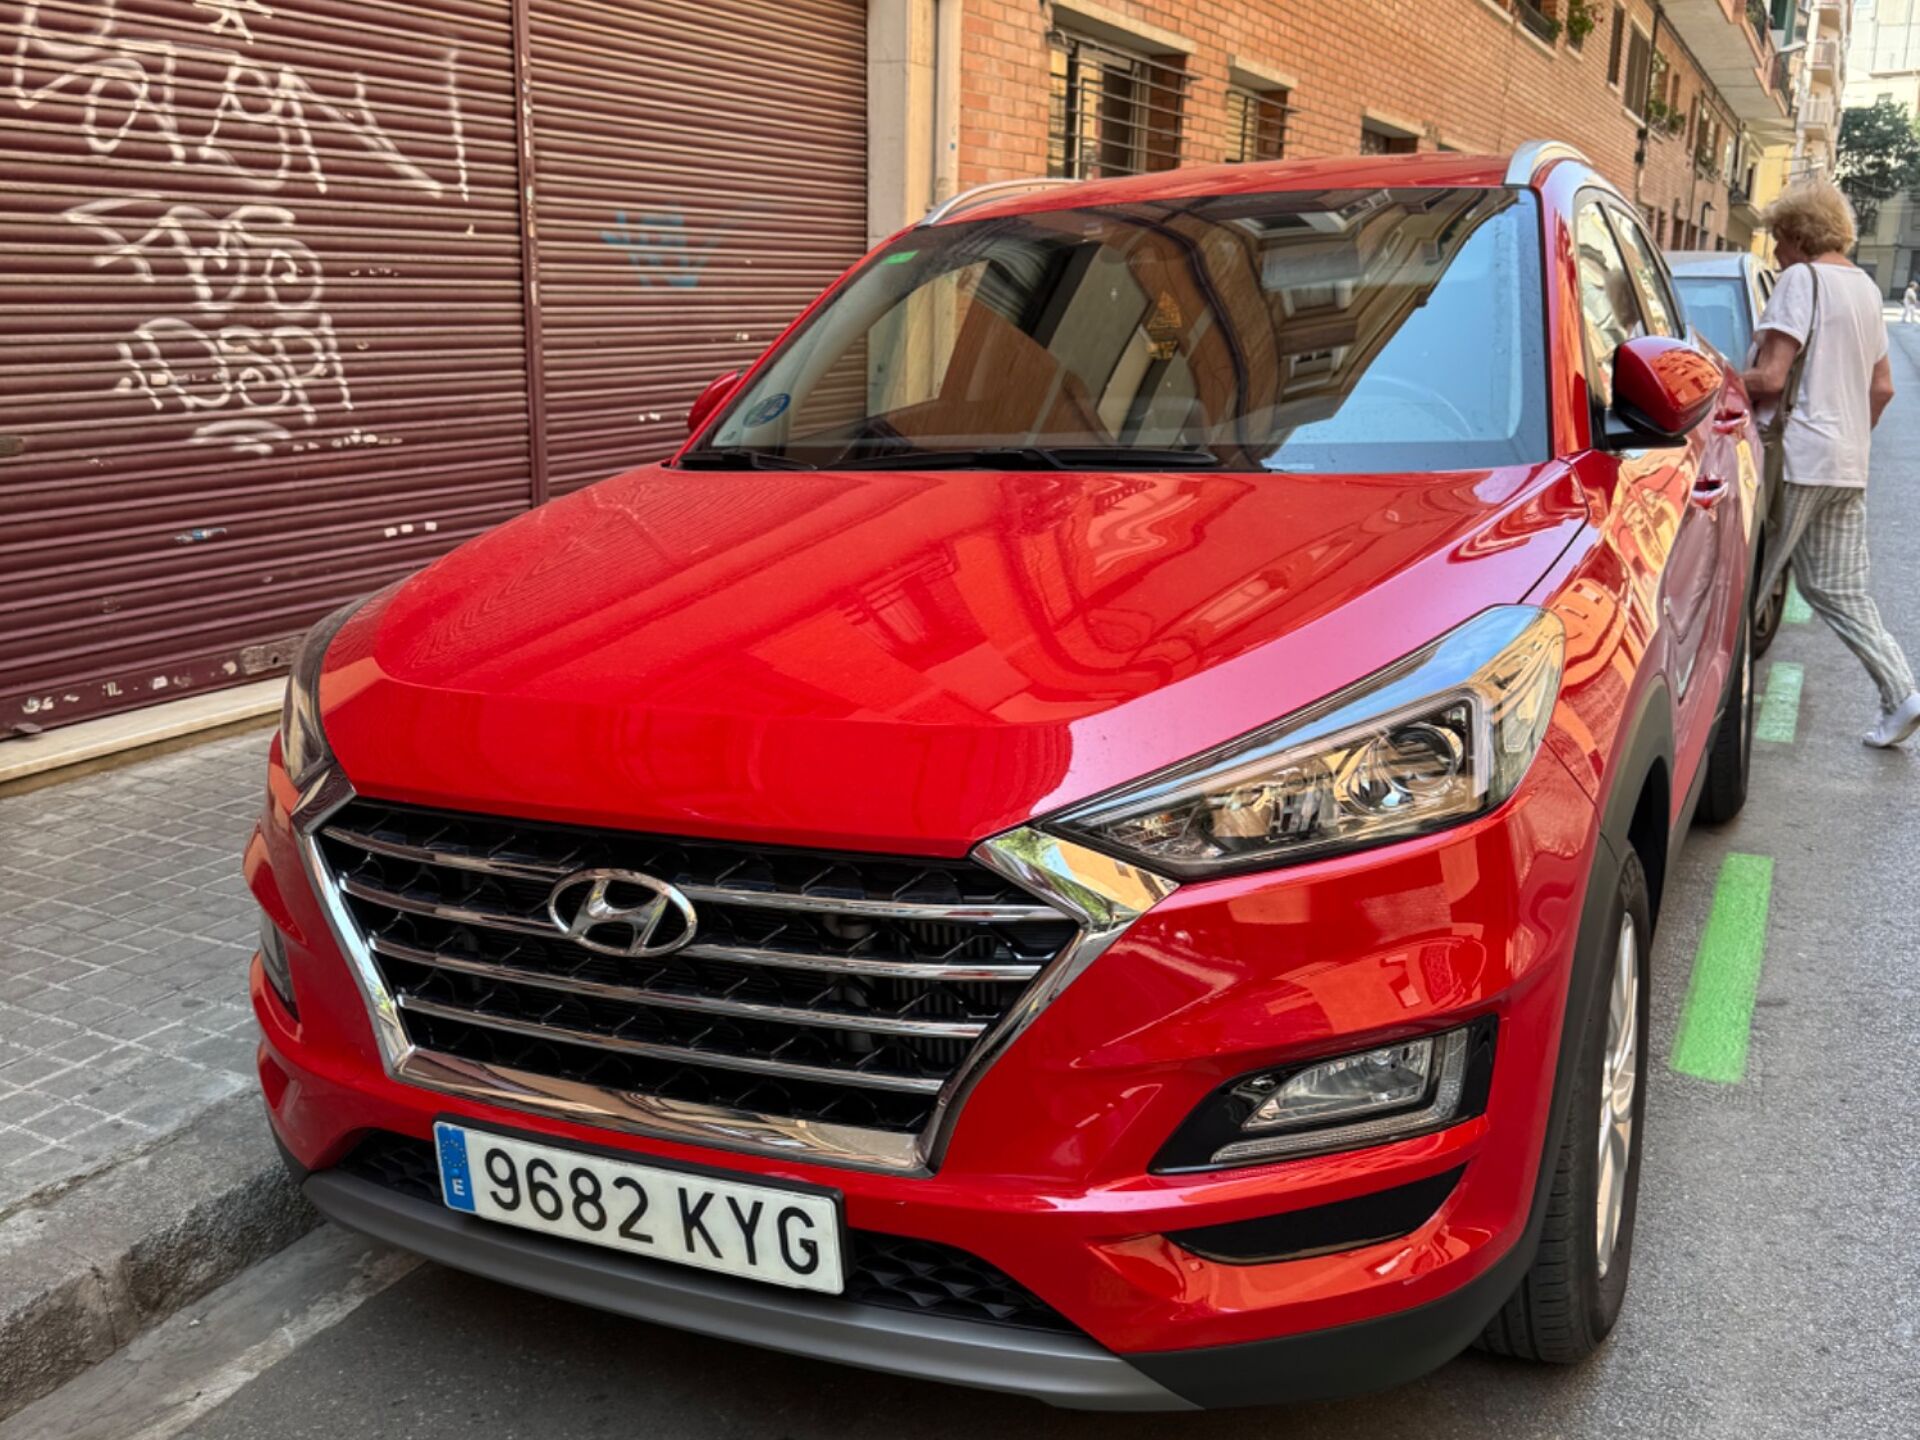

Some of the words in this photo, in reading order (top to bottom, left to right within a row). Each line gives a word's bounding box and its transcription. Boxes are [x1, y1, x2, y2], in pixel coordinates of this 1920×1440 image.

[452, 1178, 465, 1196] E
[484, 1148, 654, 1244] 9682
[677, 1187, 820, 1275] KYG
